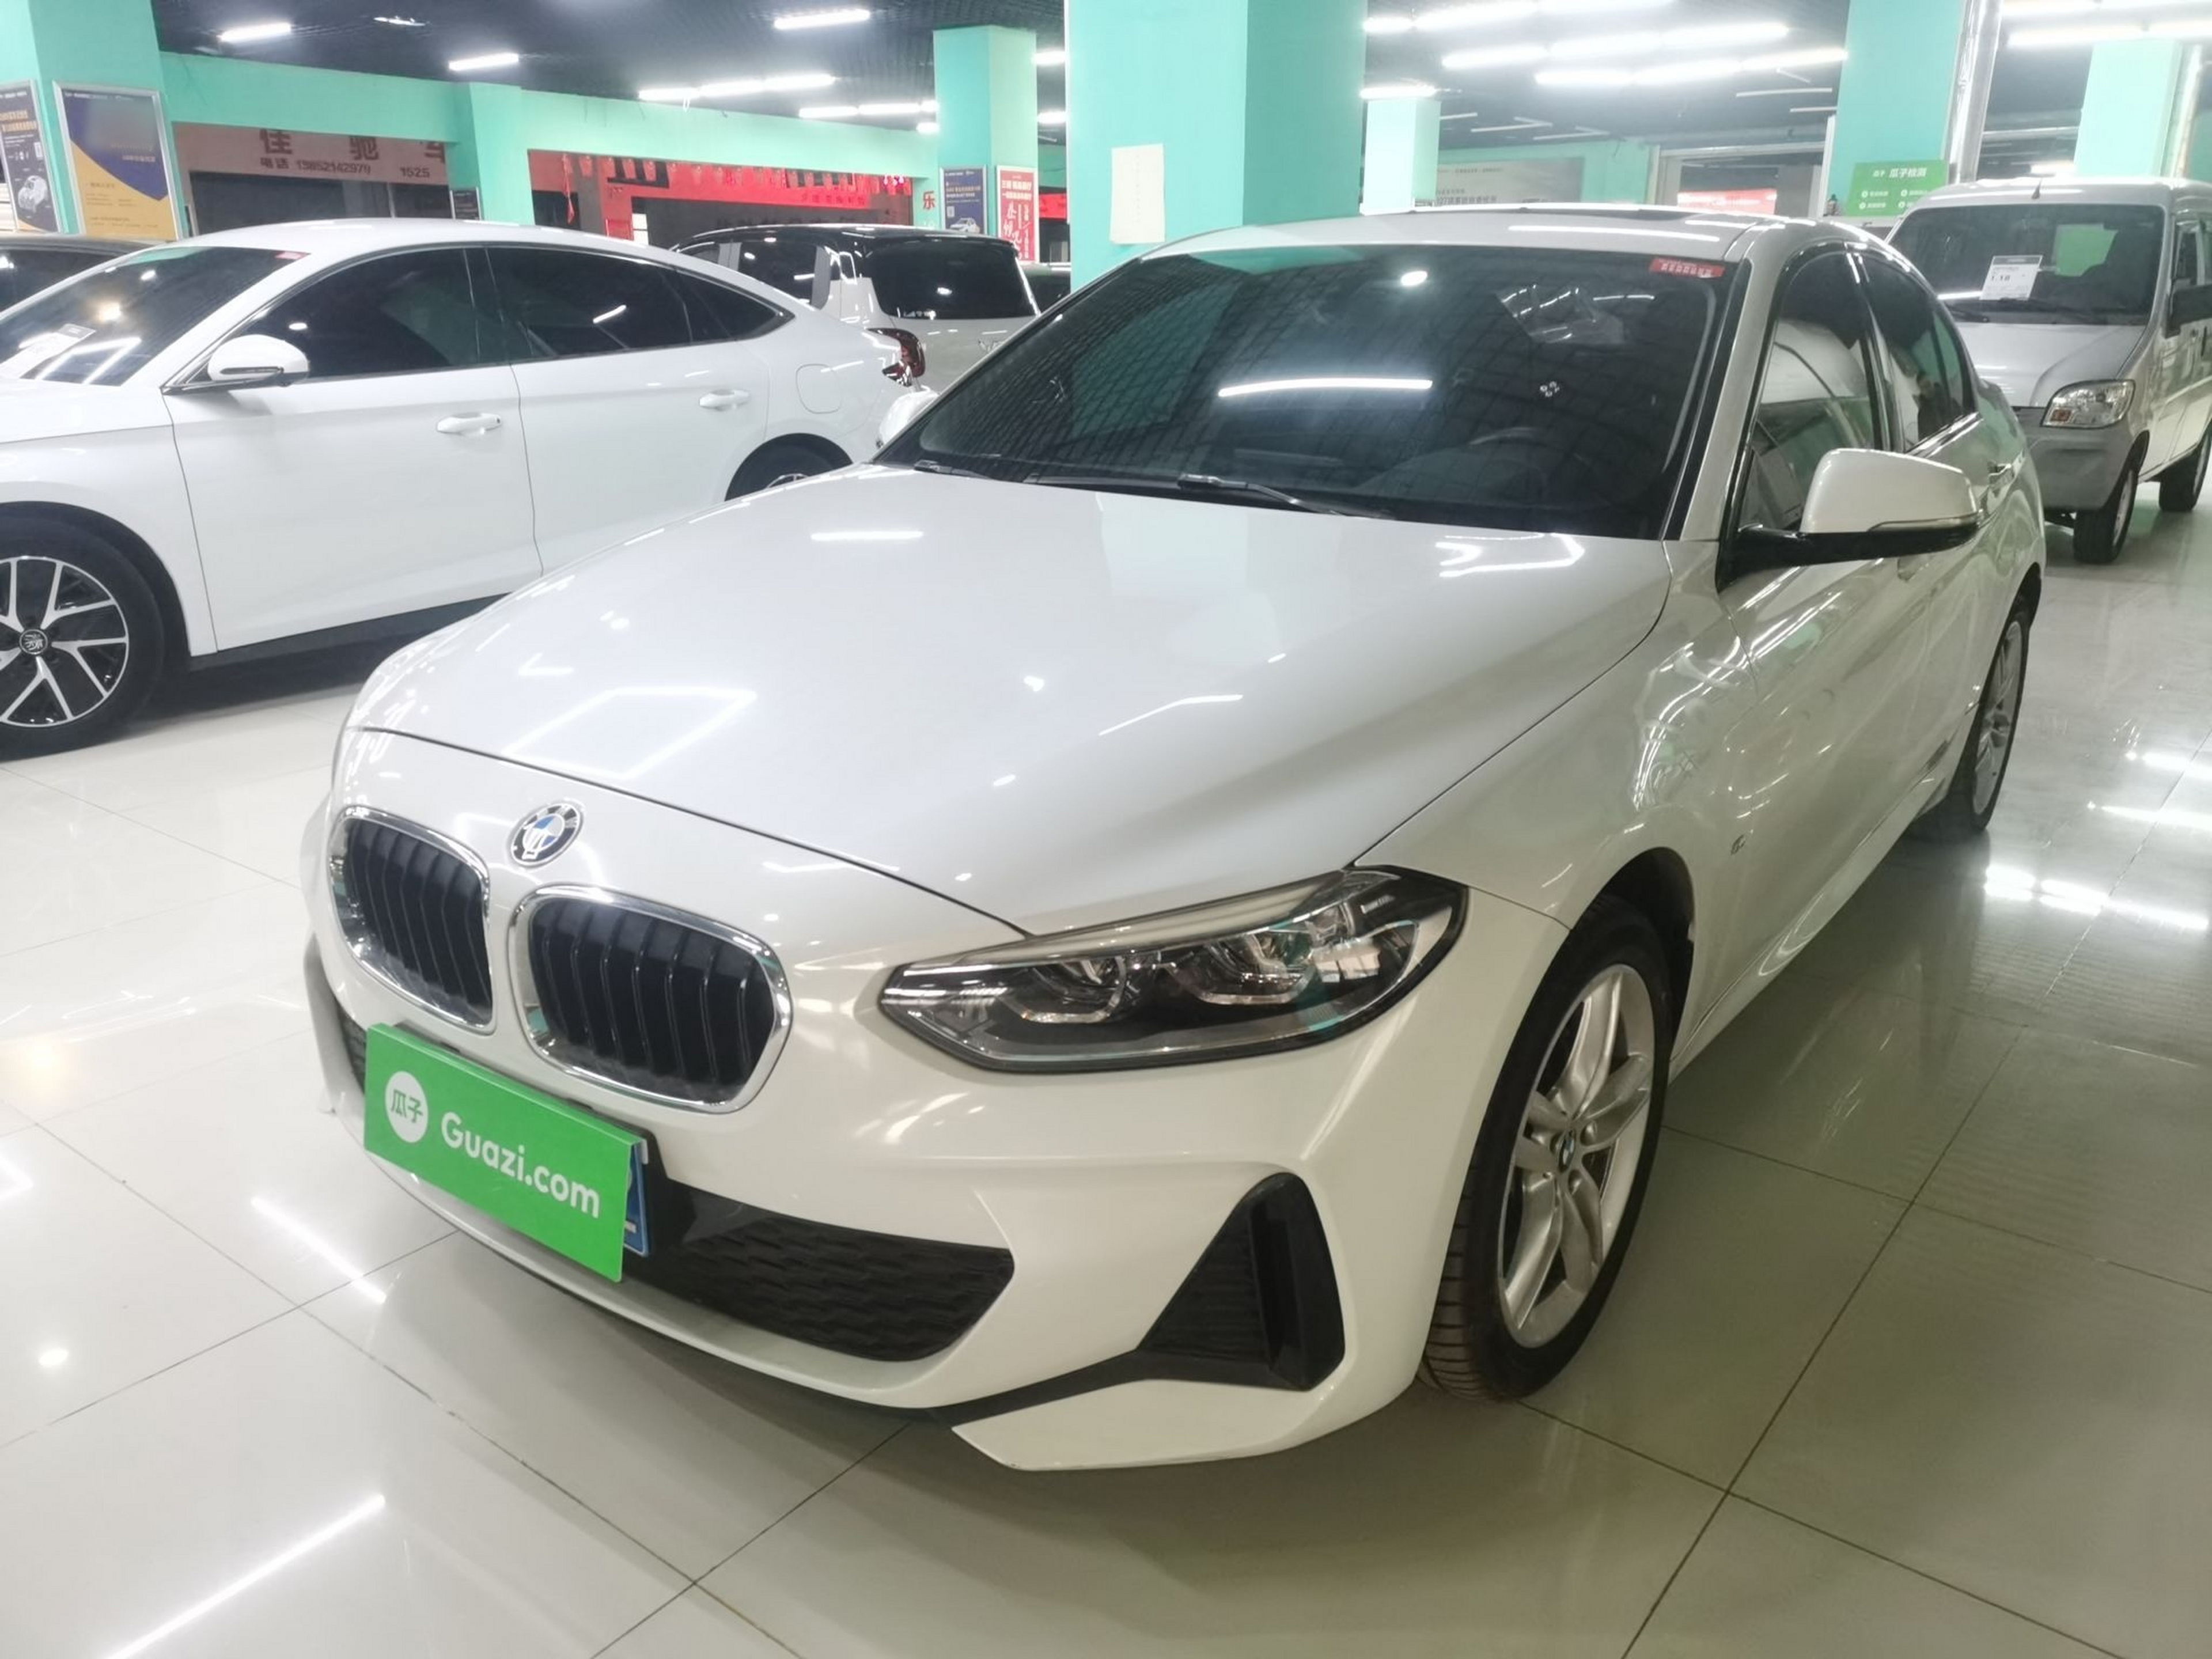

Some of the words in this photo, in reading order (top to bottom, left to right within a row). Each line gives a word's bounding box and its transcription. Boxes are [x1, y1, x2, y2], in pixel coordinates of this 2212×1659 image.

[260, 157, 289, 169] 电话
[392, 1088, 424, 1124] 瓜子
[441, 1111, 601, 1219] Guazi.com
